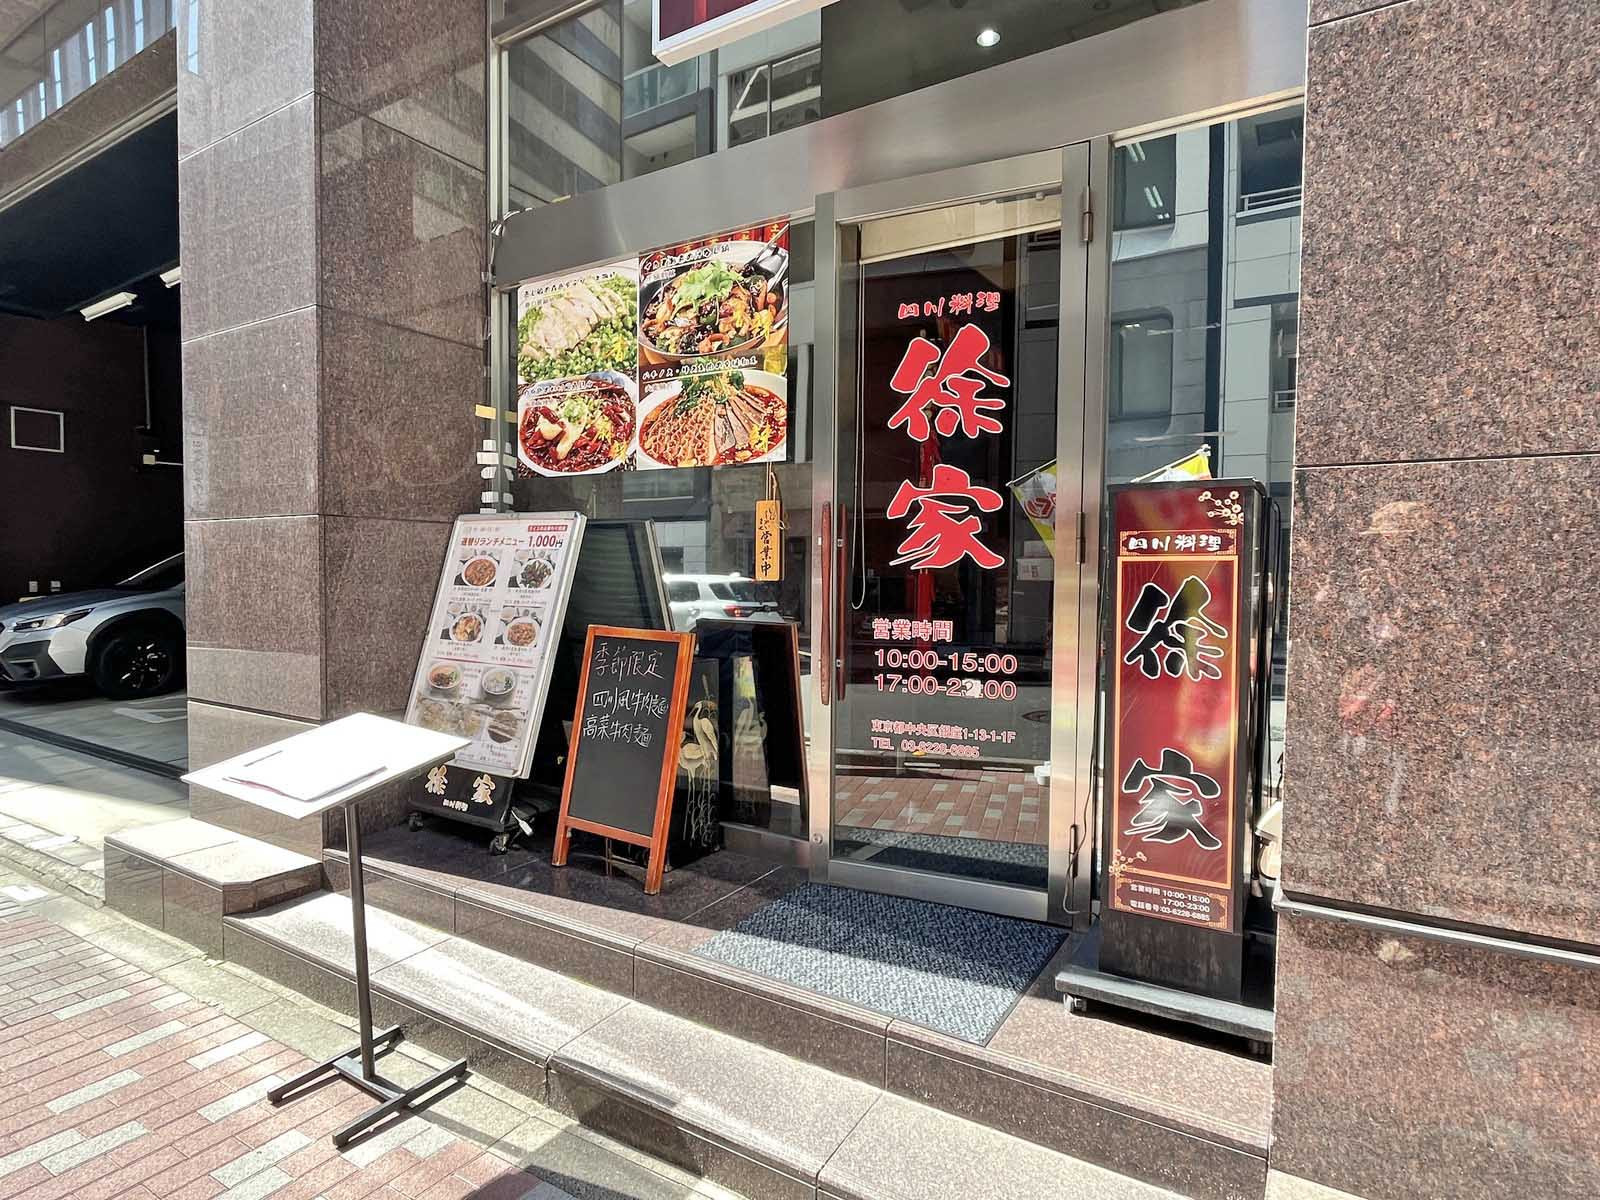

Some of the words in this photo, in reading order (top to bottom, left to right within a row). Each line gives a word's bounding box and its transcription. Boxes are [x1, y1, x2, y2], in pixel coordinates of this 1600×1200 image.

[898, 291, 1001, 320] 四川料理
[887, 323, 1010, 570] 徐家
[1128, 534, 1222, 552] 四川料理
[872, 618, 953, 642] 営業時間
[874, 649, 1018, 674] 10:00-15:00
[1124, 575, 1228, 851] 徐家
[871, 737, 894, 750] TEL
[1162, 890, 1210, 904] 10:00-15:00
[1162, 899, 1210, 912] 17:00-23:00
